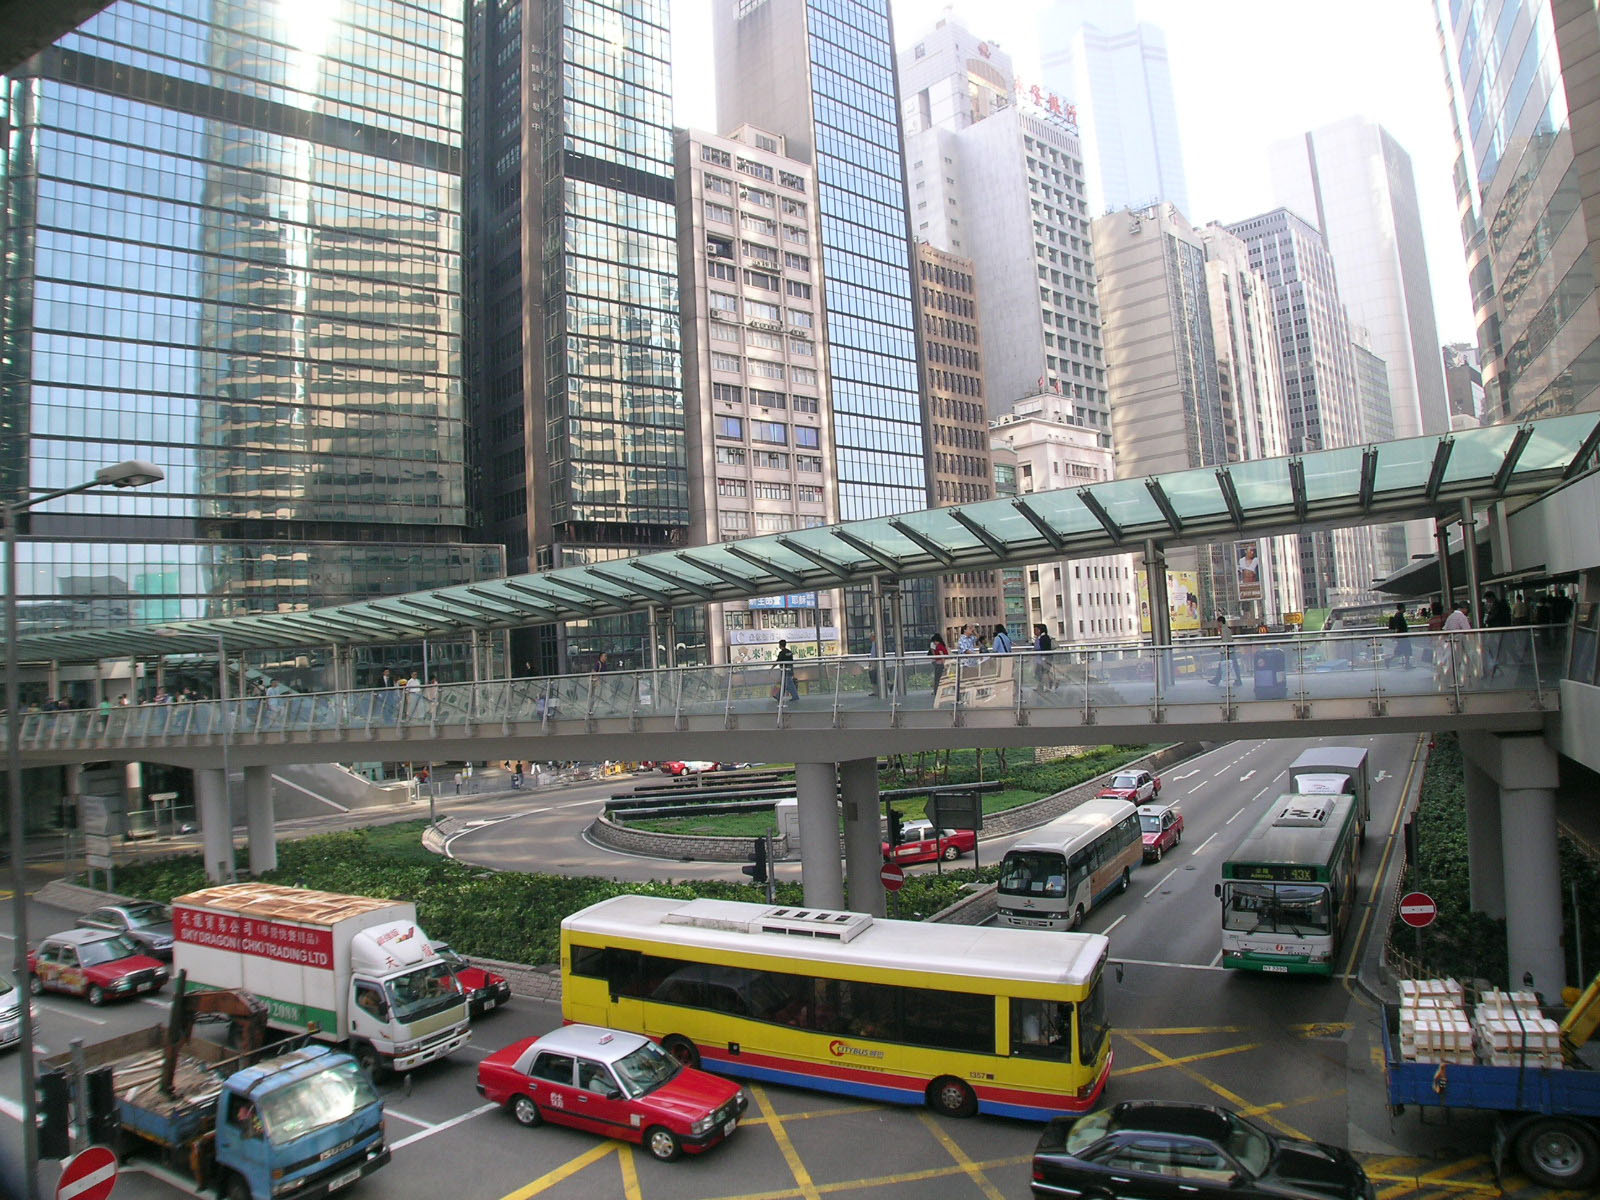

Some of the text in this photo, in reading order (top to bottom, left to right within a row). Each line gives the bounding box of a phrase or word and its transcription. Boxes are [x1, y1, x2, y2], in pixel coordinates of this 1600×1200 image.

[181, 928, 199, 941] SKY
[199, 931, 237, 949] DRAGON
[263, 942, 307, 962] TRADING
[308, 950, 328, 965] LTD
[838, 1045, 869, 1056] CITYBUS
[320, 1139, 354, 1161] ISUZU
